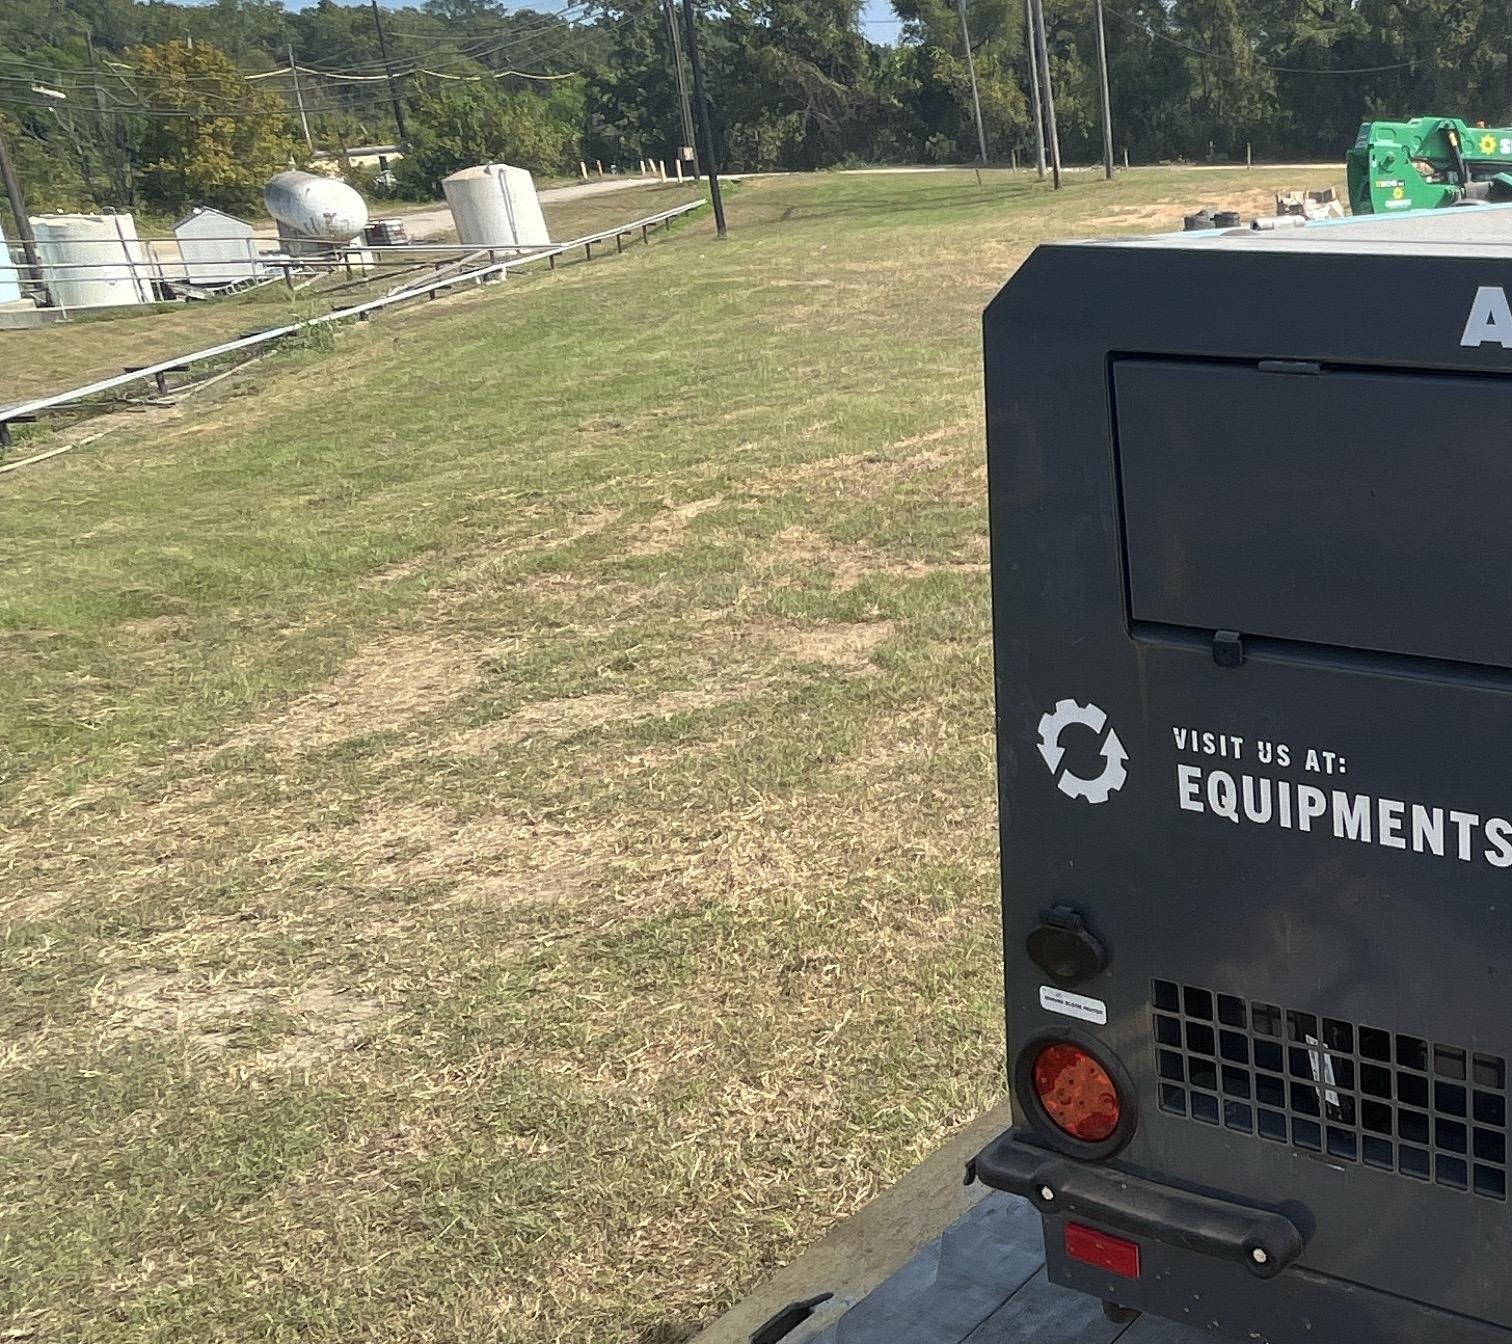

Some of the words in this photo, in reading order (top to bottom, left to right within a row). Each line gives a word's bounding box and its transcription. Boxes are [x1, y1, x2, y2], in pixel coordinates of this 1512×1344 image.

[1172, 727, 1244, 759] VISIT
[1257, 740, 1291, 767] US
[1304, 749, 1347, 775] AT:
